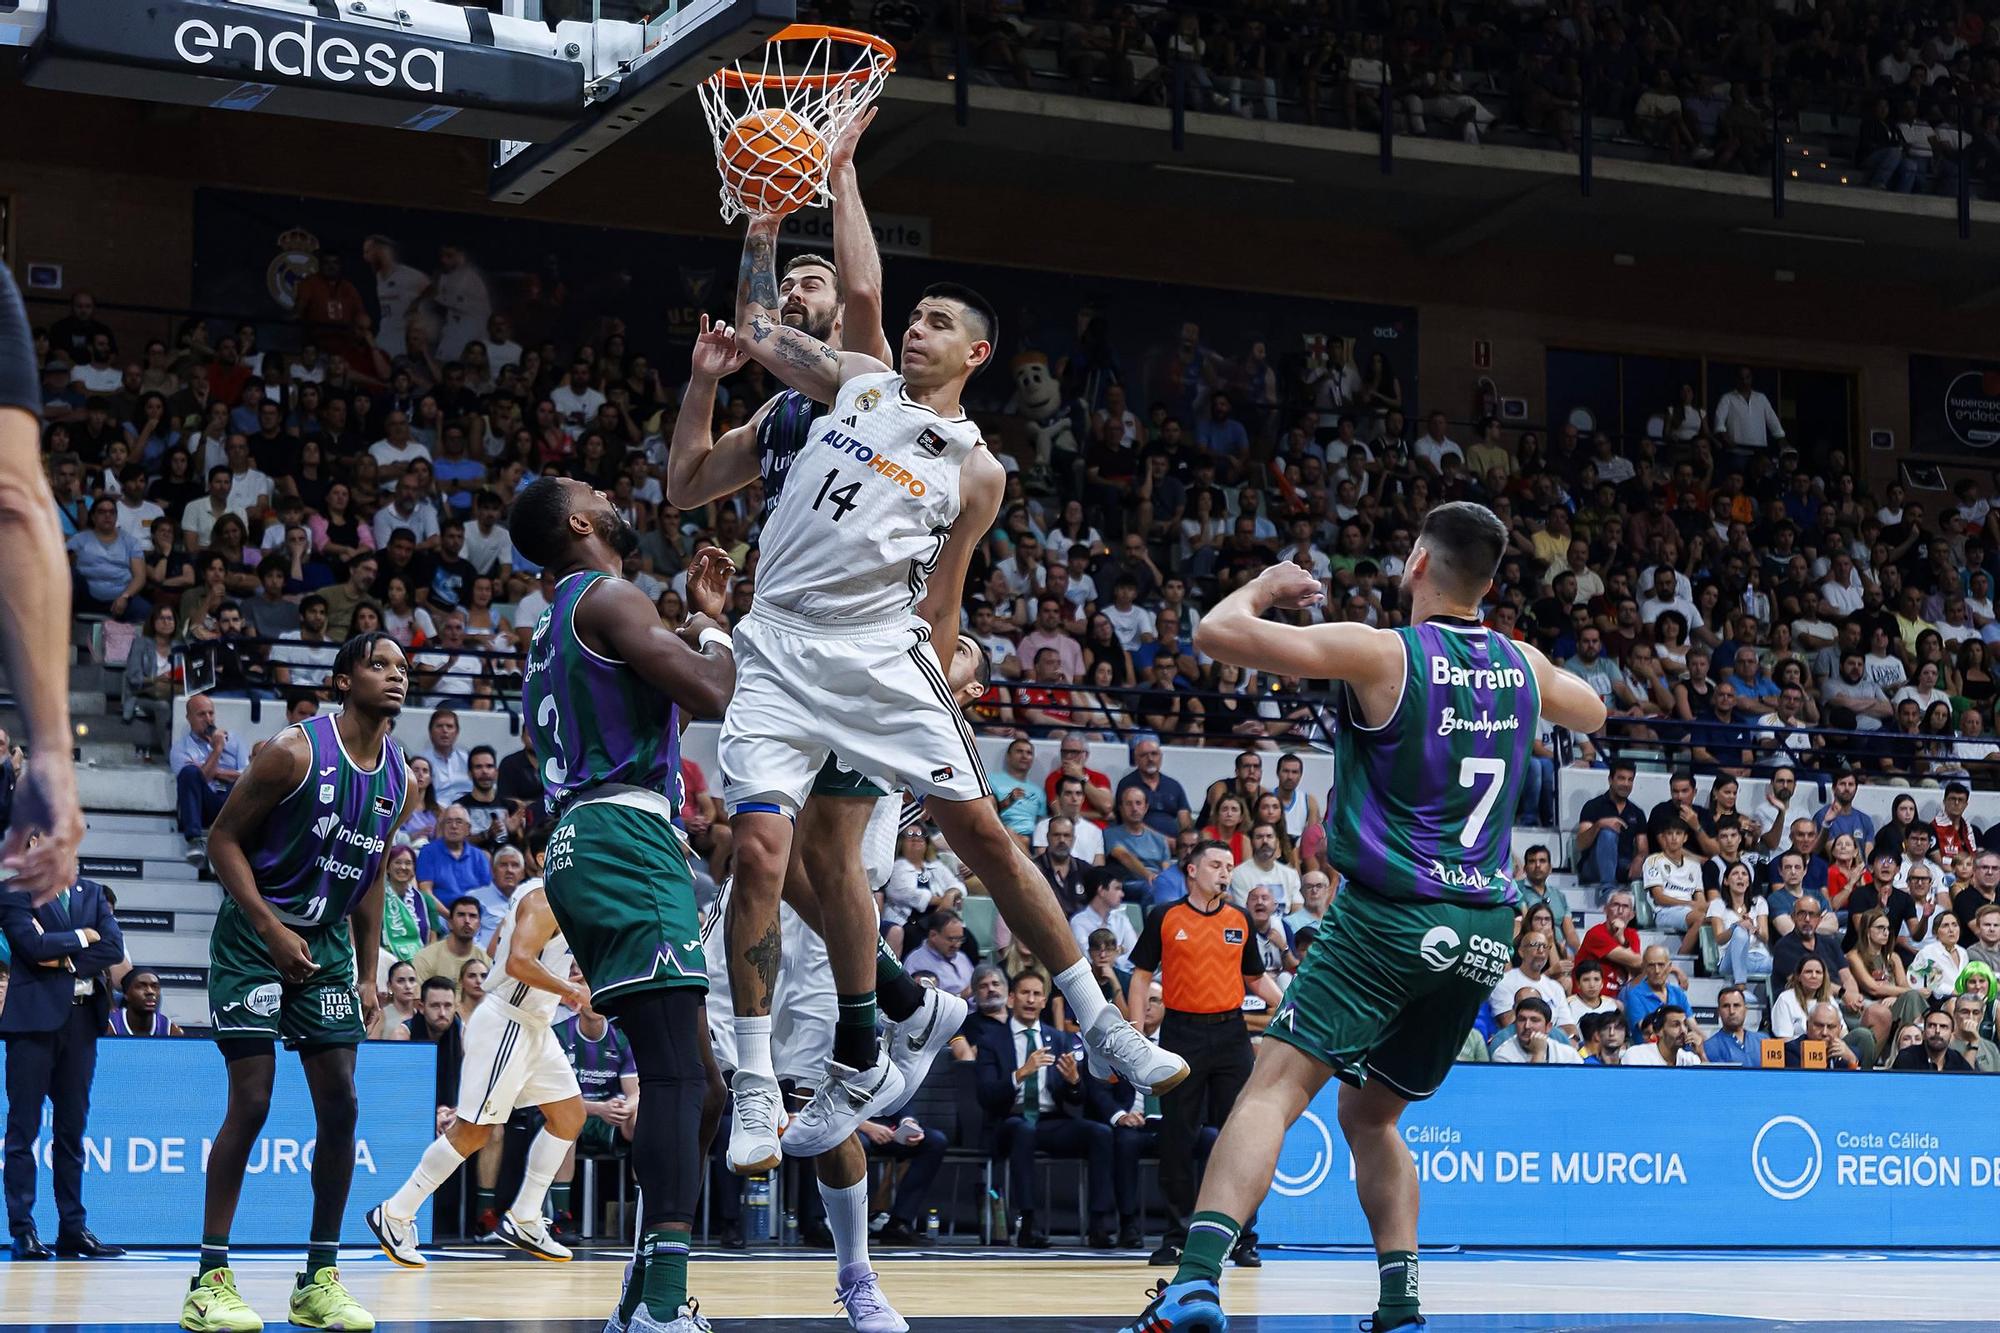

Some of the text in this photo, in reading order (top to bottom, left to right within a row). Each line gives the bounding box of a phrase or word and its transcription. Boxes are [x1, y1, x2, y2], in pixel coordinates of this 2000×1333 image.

[174, 19, 444, 93] endesa
[785, 214, 922, 247] ada orte
[820, 429, 926, 497] AUTOHERO
[811, 468, 863, 522] 14
[1431, 655, 1525, 690] Barreiro
[538, 694, 568, 784] 3
[1459, 757, 1506, 848] 7
[307, 896, 328, 922] 11
[1463, 951, 1505, 975] DEL SO
[321, 1001, 354, 1019] laga
[325, 989, 351, 1004] má
[1767, 1050, 1783, 1060] IRS
[1808, 1051, 1824, 1061] IRS
[1405, 1125, 1462, 1144] Cálida
[1836, 1132, 1939, 1149] Costa Cálida
[127, 1137, 186, 1174] DE
[1496, 1151, 1540, 1183] DE
[1551, 1151, 1688, 1185] MURCIA
[1837, 1151, 1960, 1187] REGIÓN
